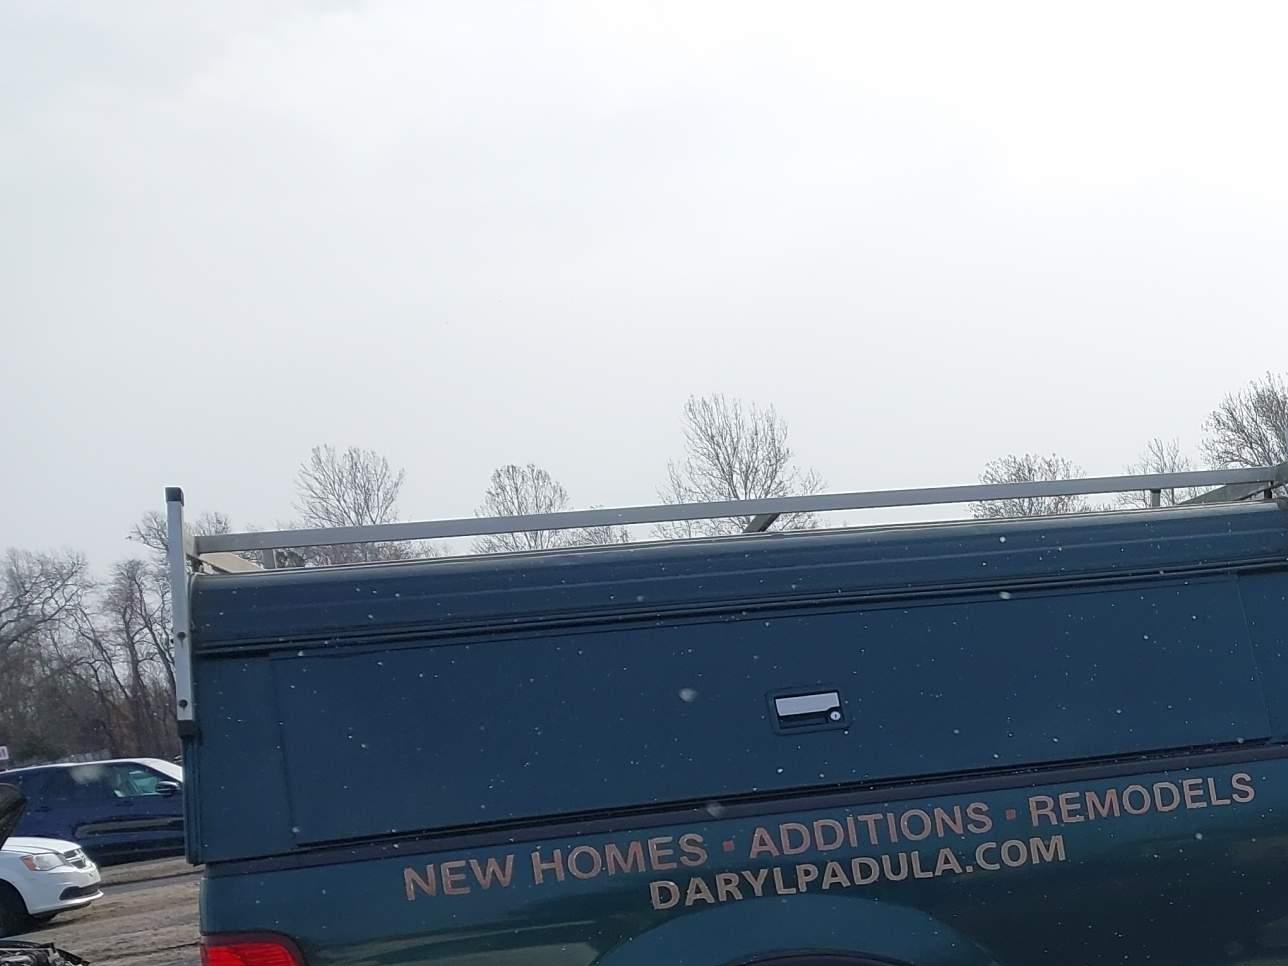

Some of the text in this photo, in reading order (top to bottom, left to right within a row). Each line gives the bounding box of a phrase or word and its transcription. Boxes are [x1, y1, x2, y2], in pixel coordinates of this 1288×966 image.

[403, 772, 1255, 901] NEW HOMES ADDITIONS REMODELS
[650, 835, 1066, 910] DARYLPADULA.COM
